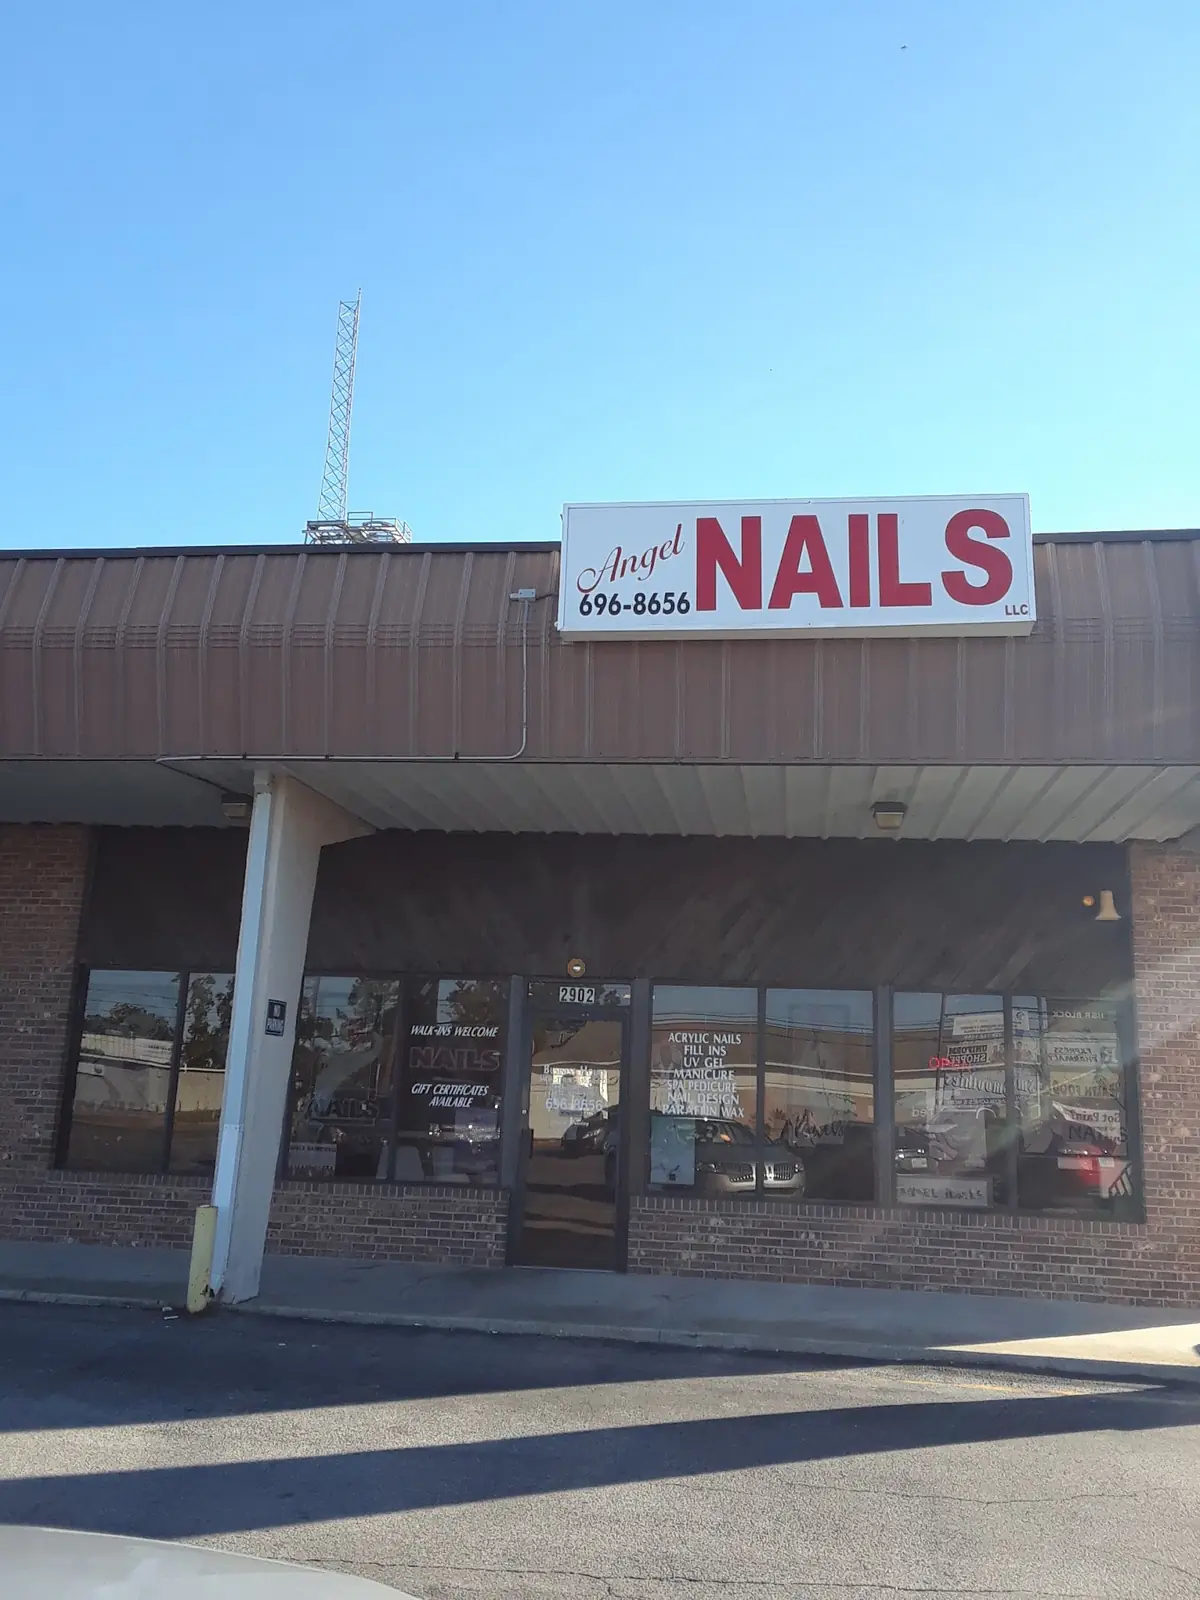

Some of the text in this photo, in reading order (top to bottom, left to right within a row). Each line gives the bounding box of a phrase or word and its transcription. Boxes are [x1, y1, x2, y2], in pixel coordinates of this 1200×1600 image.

[577, 524, 684, 593] Angel
[696, 508, 1014, 612] NAILS
[579, 592, 691, 617] 696-8656
[1005, 604, 1029, 617] LLC
[560, 987, 595, 1003] 2902
[411, 1025, 499, 1037] WALK-INS WELCOME
[668, 1032, 742, 1045] ACRYLIC NAILS
[684, 1045, 727, 1057] FILL INS
[409, 1046, 500, 1071] NAILS
[683, 1056, 725, 1069] UV GEL
[673, 1068, 735, 1081] MANICURE
[411, 1083, 489, 1096] GIFT CERTIFICATES
[667, 1080, 737, 1093] SPA PEDICURE
[429, 1096, 473, 1108] AVAILABLE
[667, 1091, 740, 1105] NAIL DESIGN
[720, 1106, 745, 1118] WAX
